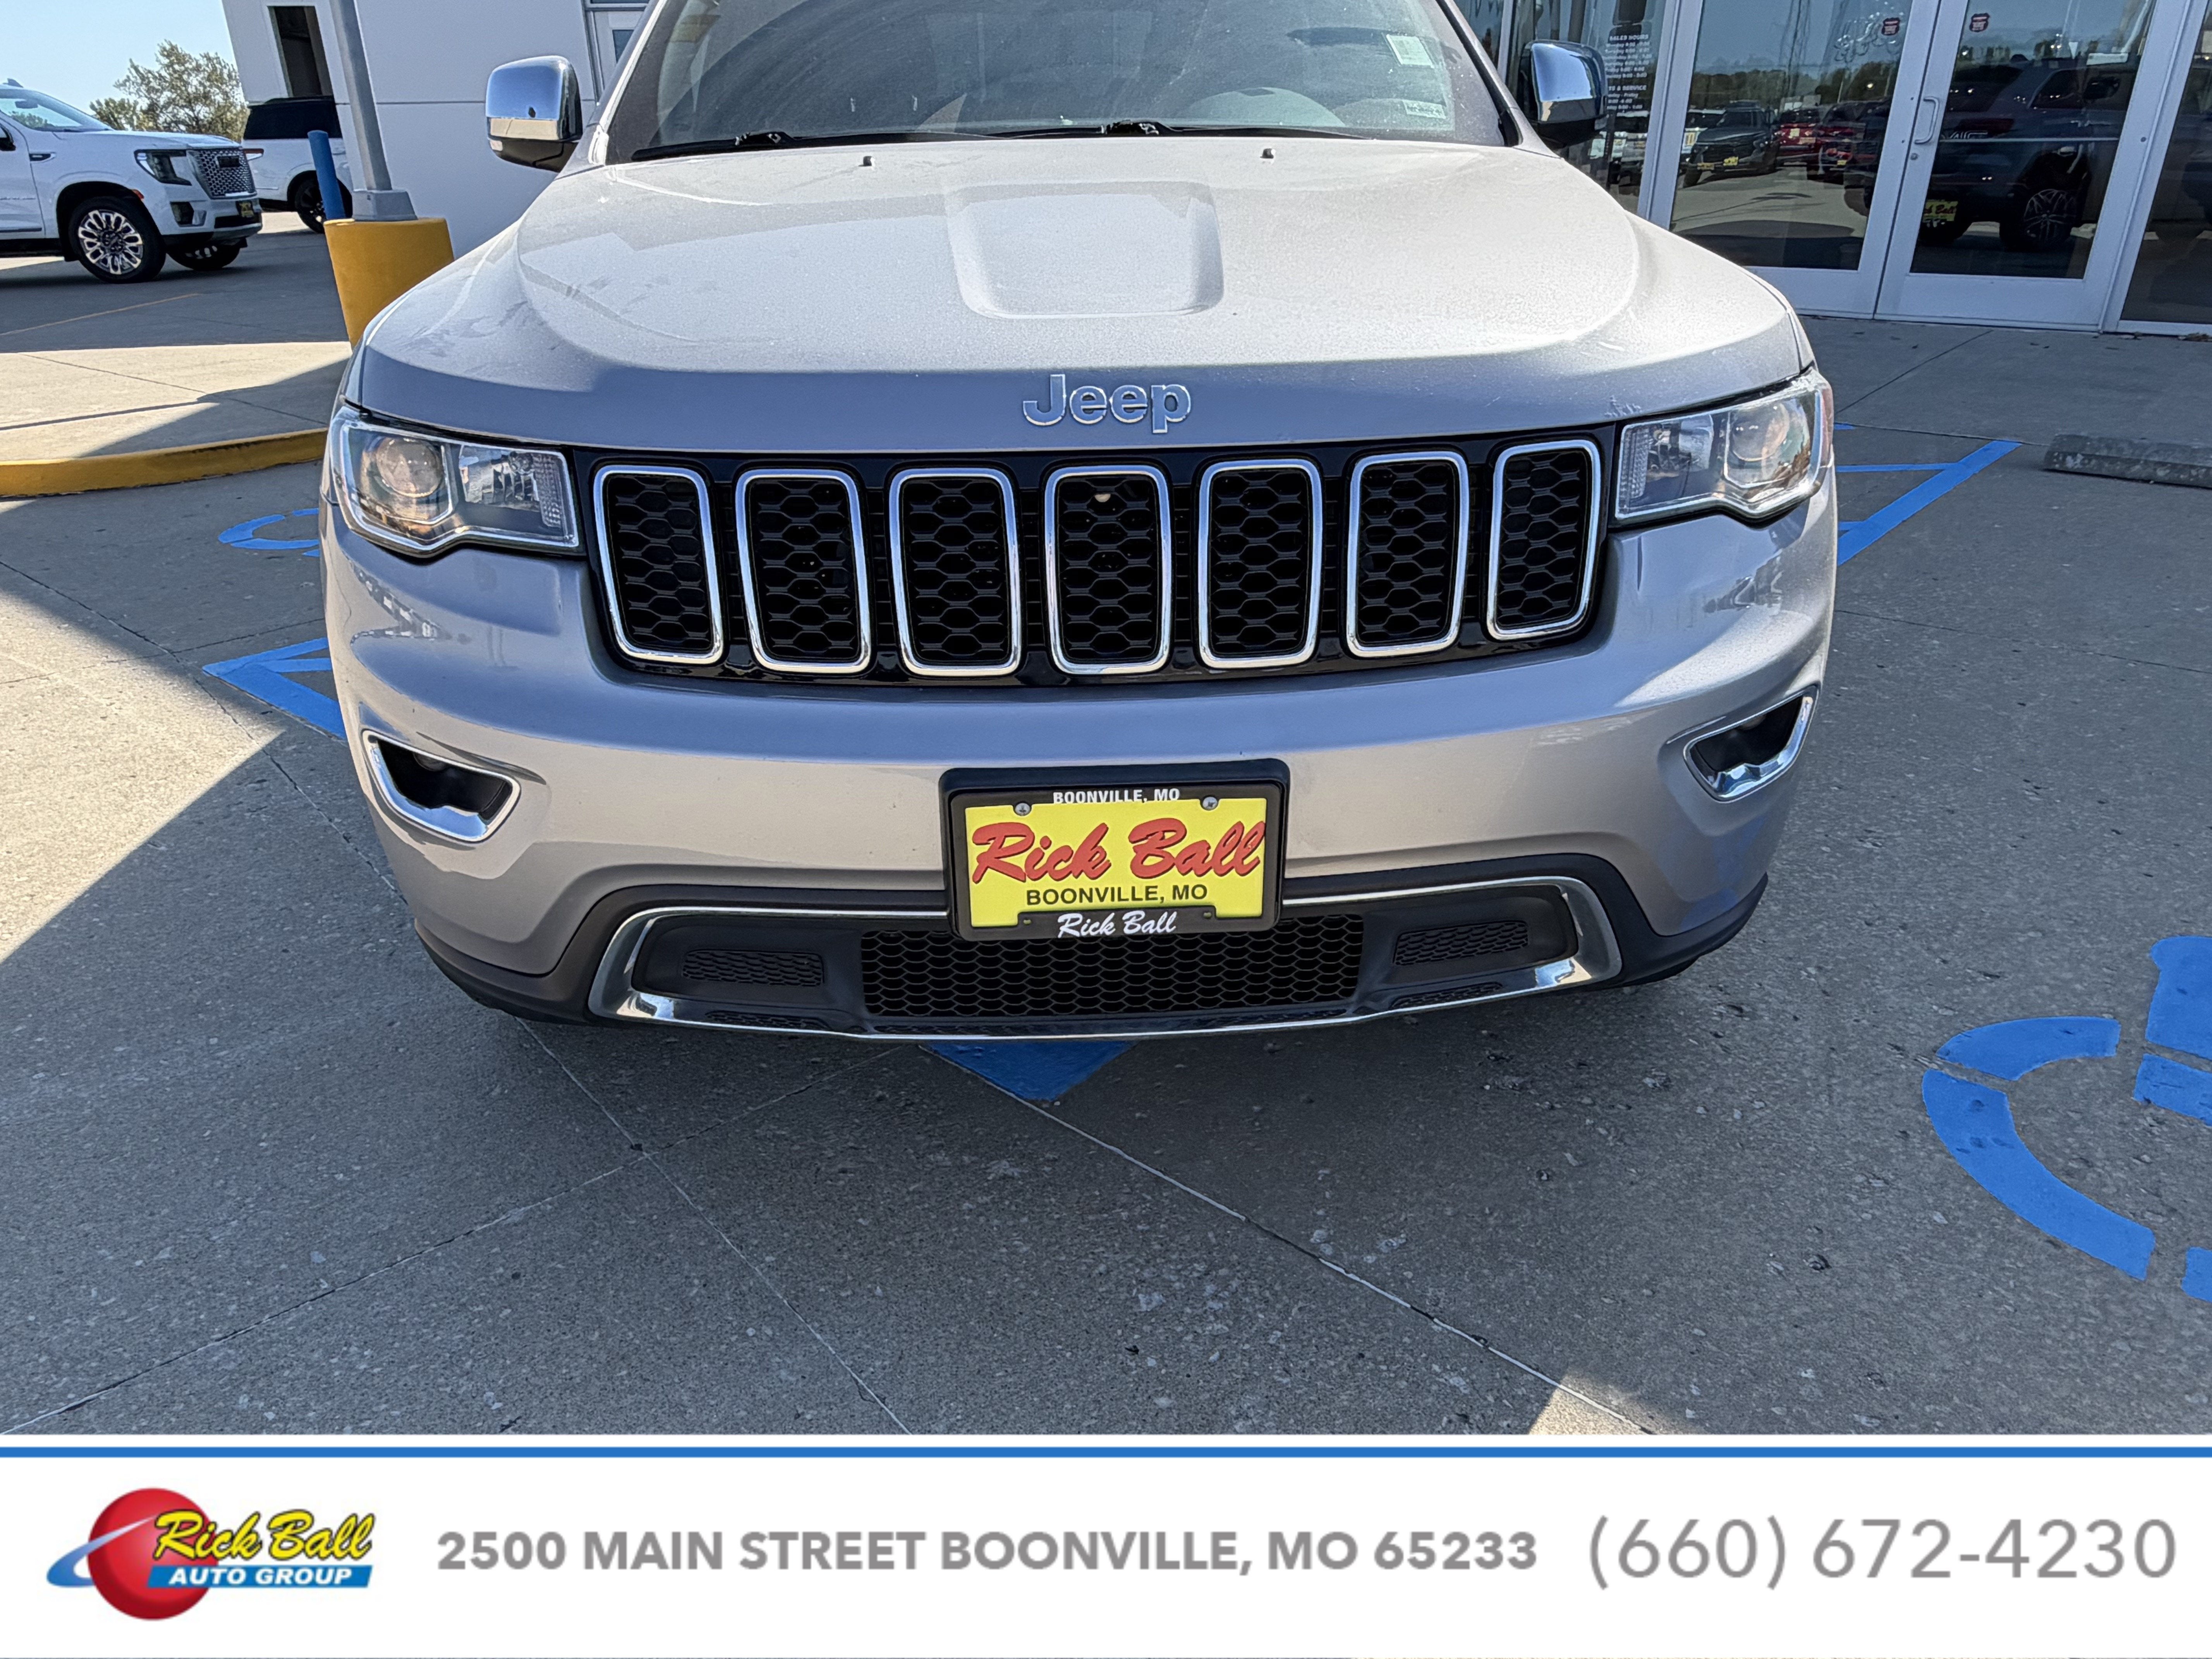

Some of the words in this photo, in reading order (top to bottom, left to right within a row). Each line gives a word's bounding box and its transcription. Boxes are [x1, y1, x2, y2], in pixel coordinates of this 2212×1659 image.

[1023, 374, 1192, 434] Jeep
[1053, 789, 1148, 804] BOONVILLE,
[1154, 788, 1180, 801] MO
[972, 822, 1112, 884] Rick
[1128, 817, 1266, 879] Ball
[1027, 885, 1164, 905] BOONVILLE,
[1172, 884, 1207, 900] MO
[1057, 912, 1116, 938] Rick
[1122, 910, 1177, 935] Ball
